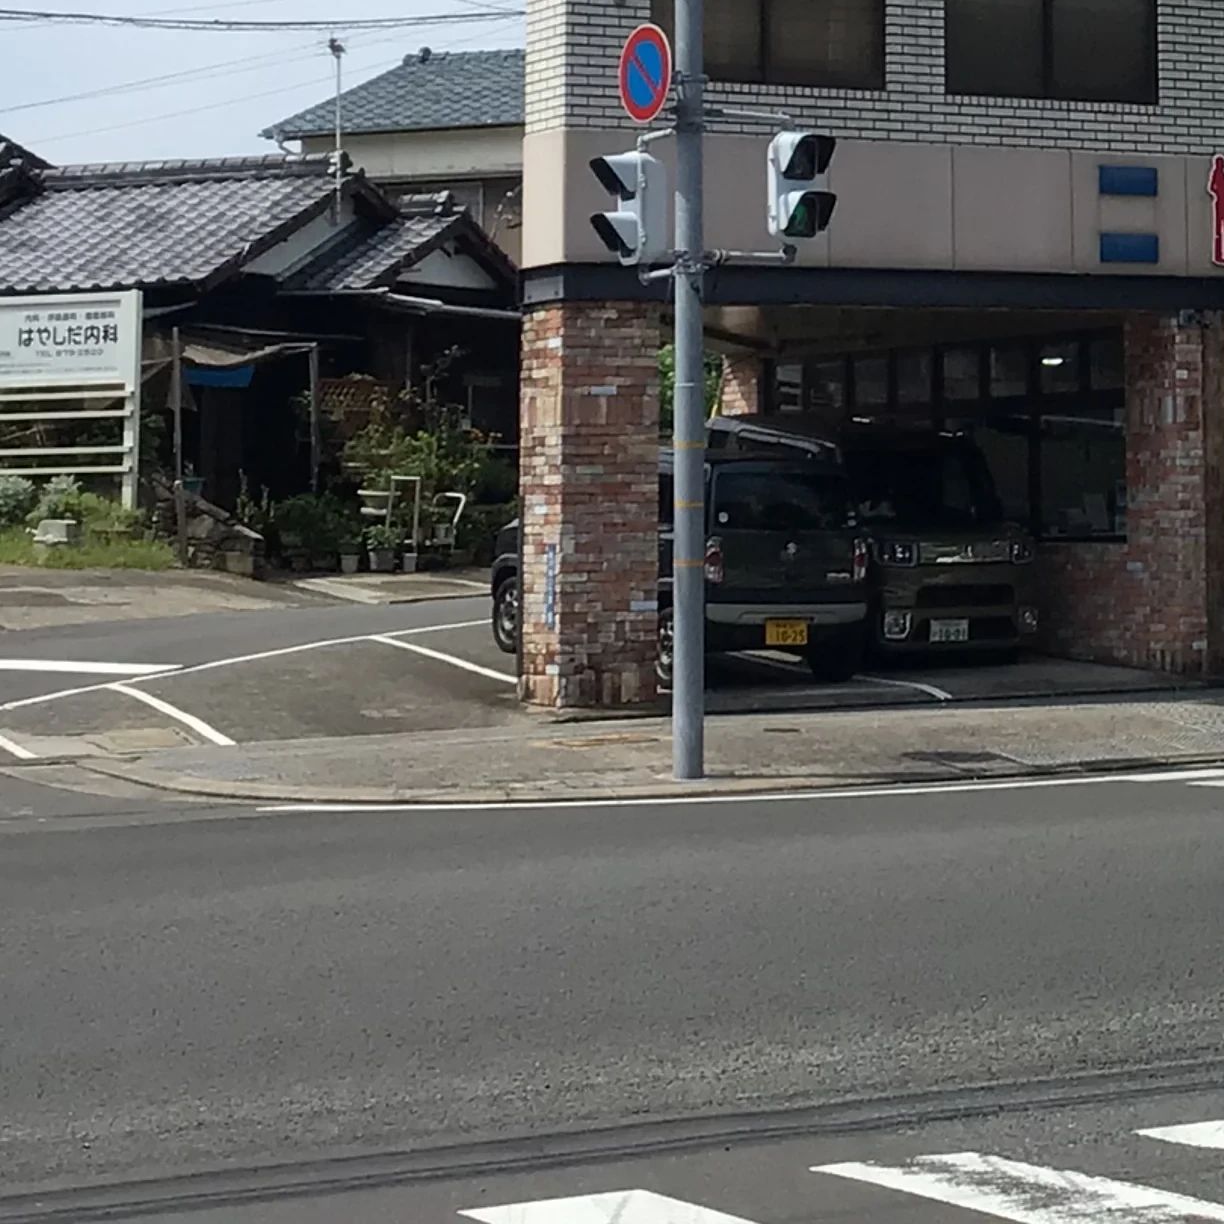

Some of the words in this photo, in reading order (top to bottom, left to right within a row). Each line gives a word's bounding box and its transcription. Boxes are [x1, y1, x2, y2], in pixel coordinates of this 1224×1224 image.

[18, 324, 118, 347] はやしだ内科
